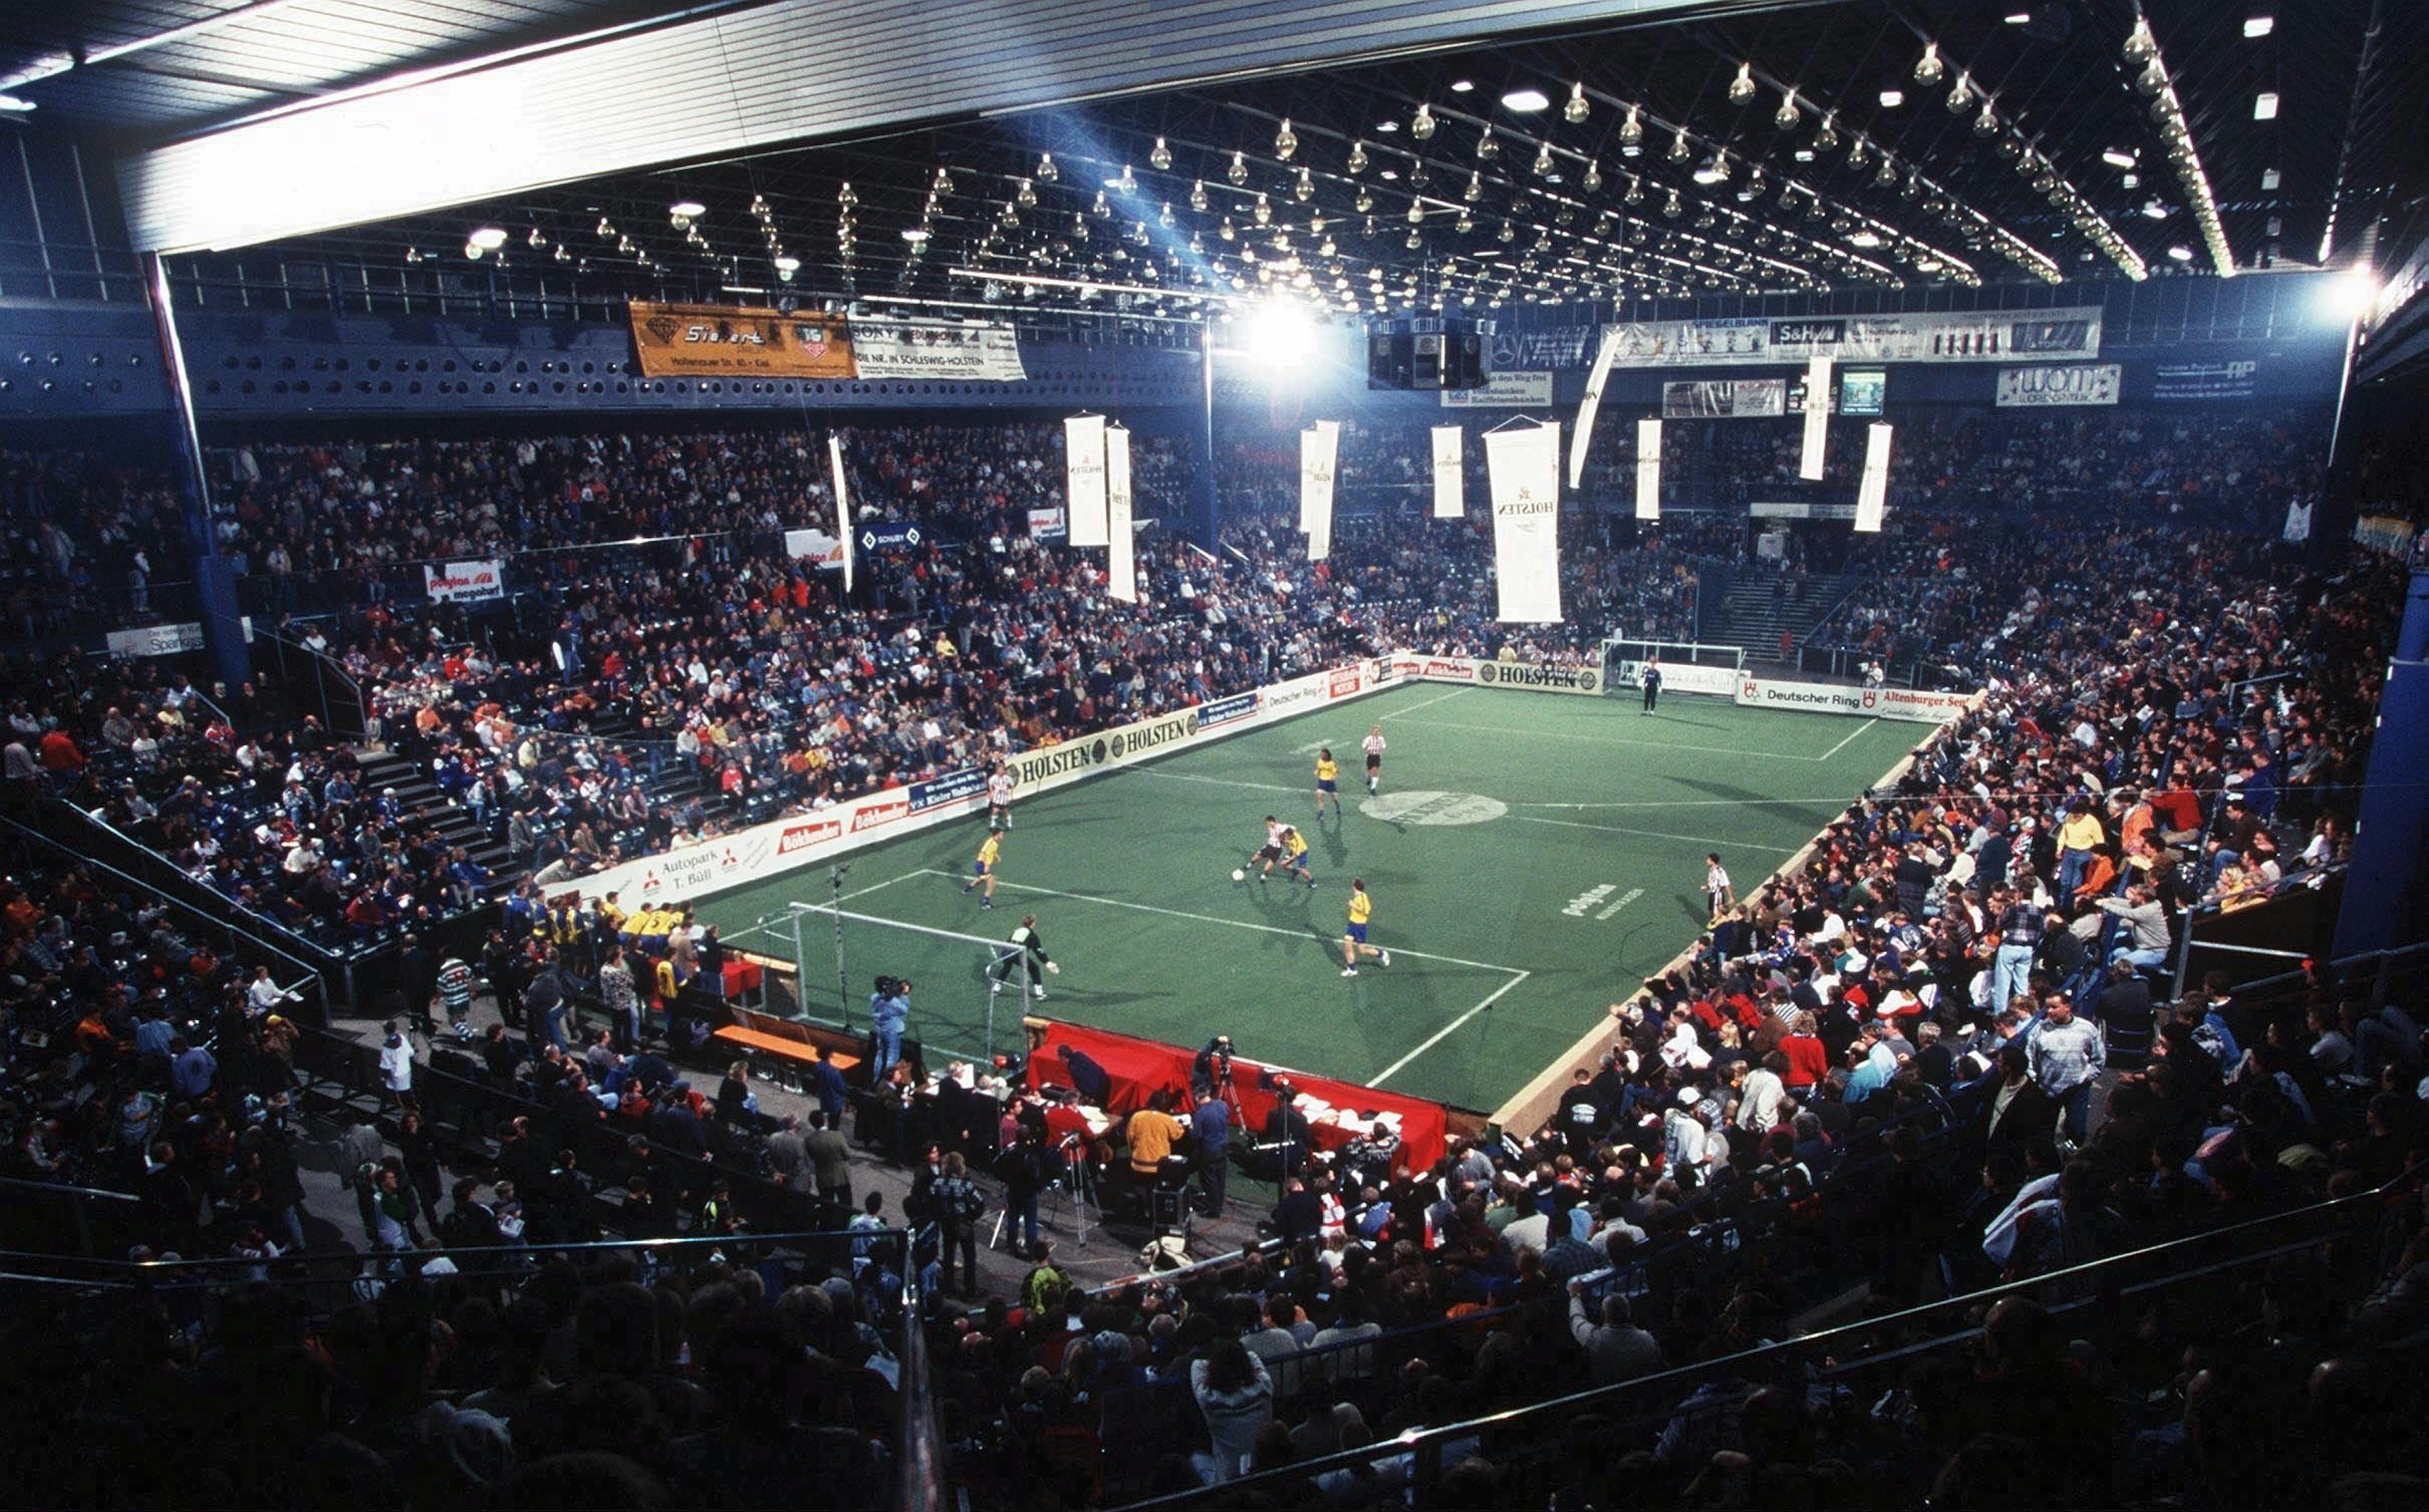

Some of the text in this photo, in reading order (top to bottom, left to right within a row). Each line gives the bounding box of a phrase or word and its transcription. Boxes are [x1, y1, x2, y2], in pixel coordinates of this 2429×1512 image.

[685, 326, 766, 344] Sieert
[850, 325, 894, 338] SONY
[900, 355, 985, 366] SCHLESWIG-HOLSTEIN
[1471, 395, 1547, 403] Raiffeisenbanken
[1498, 666, 1576, 688] HOLSTEN
[1767, 689, 1860, 709] Deutscher Ring
[1884, 690, 1944, 707] Altenburger
[1127, 718, 1185, 753] HOLSTEN
[1022, 744, 1092, 784] HOLSTEN
[664, 850, 719, 874] Autopark
[674, 877, 684, 890] T.
